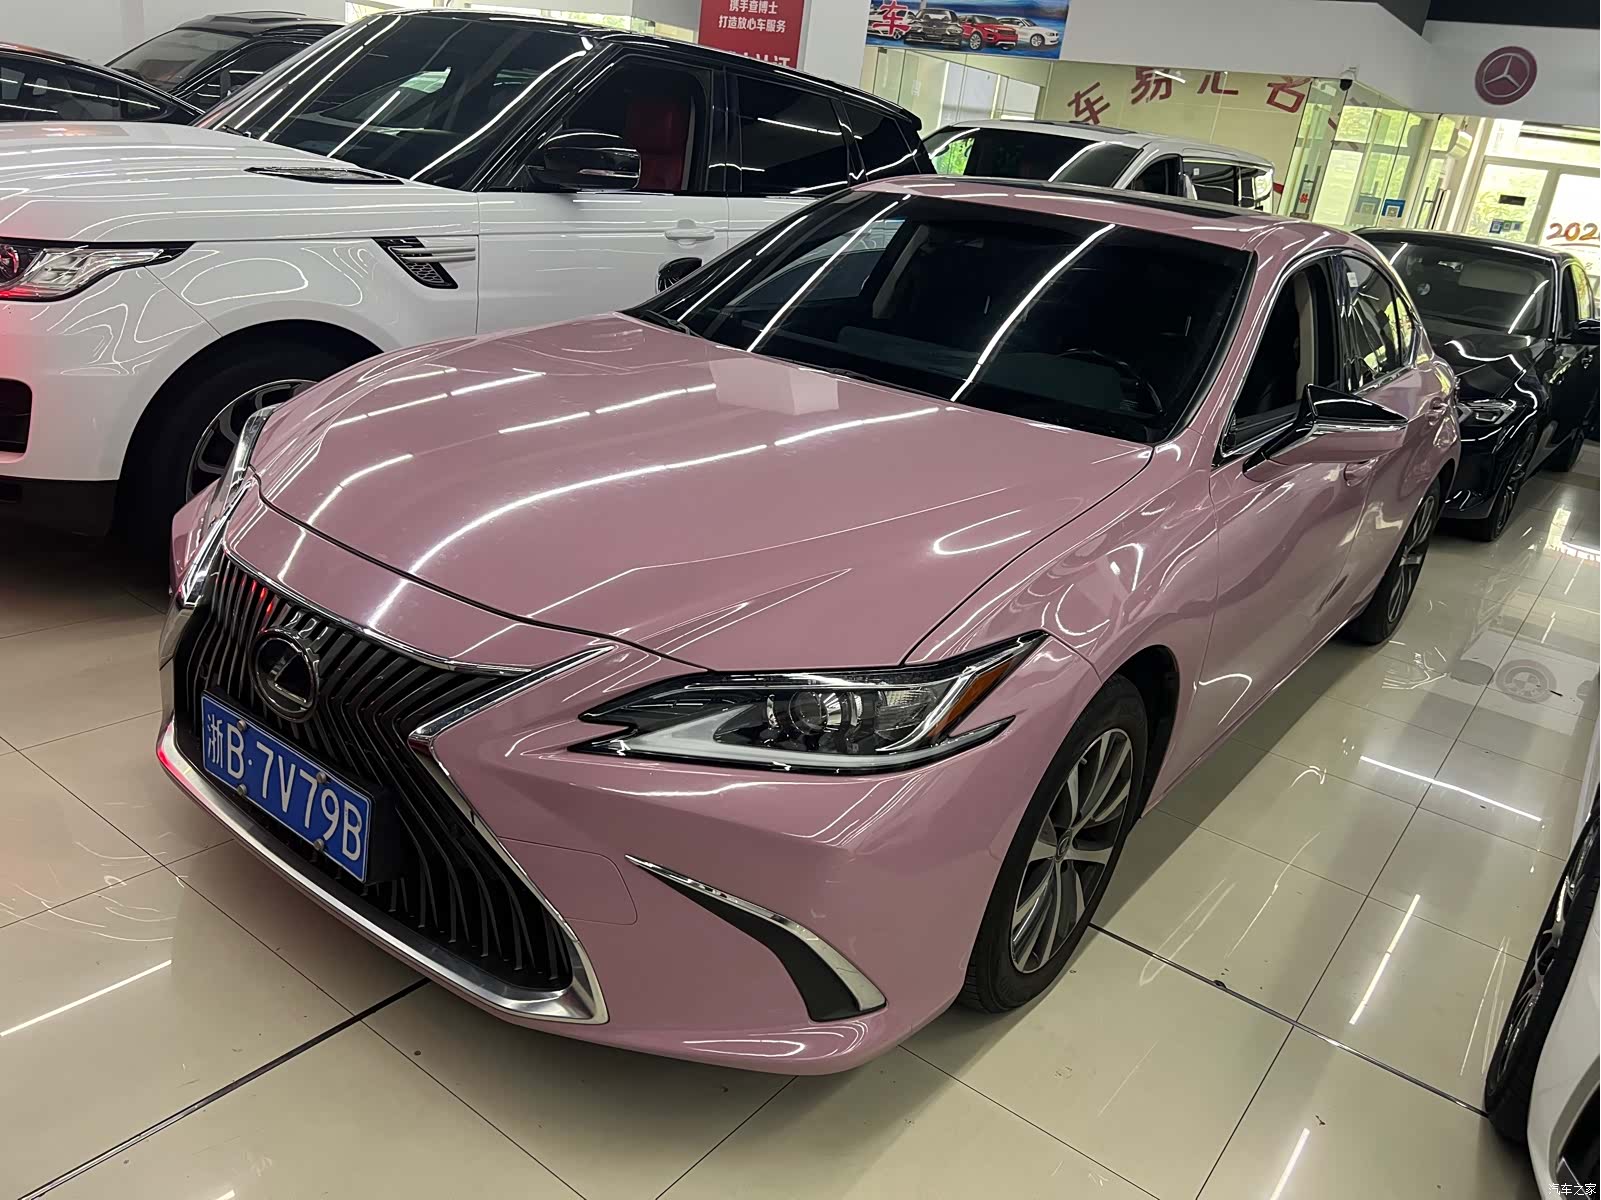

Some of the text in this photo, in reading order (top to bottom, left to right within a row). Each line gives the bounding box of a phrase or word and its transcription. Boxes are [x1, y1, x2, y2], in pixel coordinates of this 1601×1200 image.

[729, 0, 779, 14] 携手查博士
[718, 15, 787, 33] 打造放心车服务
[872, 0, 912, 36] 车
[1546, 222, 1600, 241] 202
[207, 713, 363, 861] 浙B·7V79B
